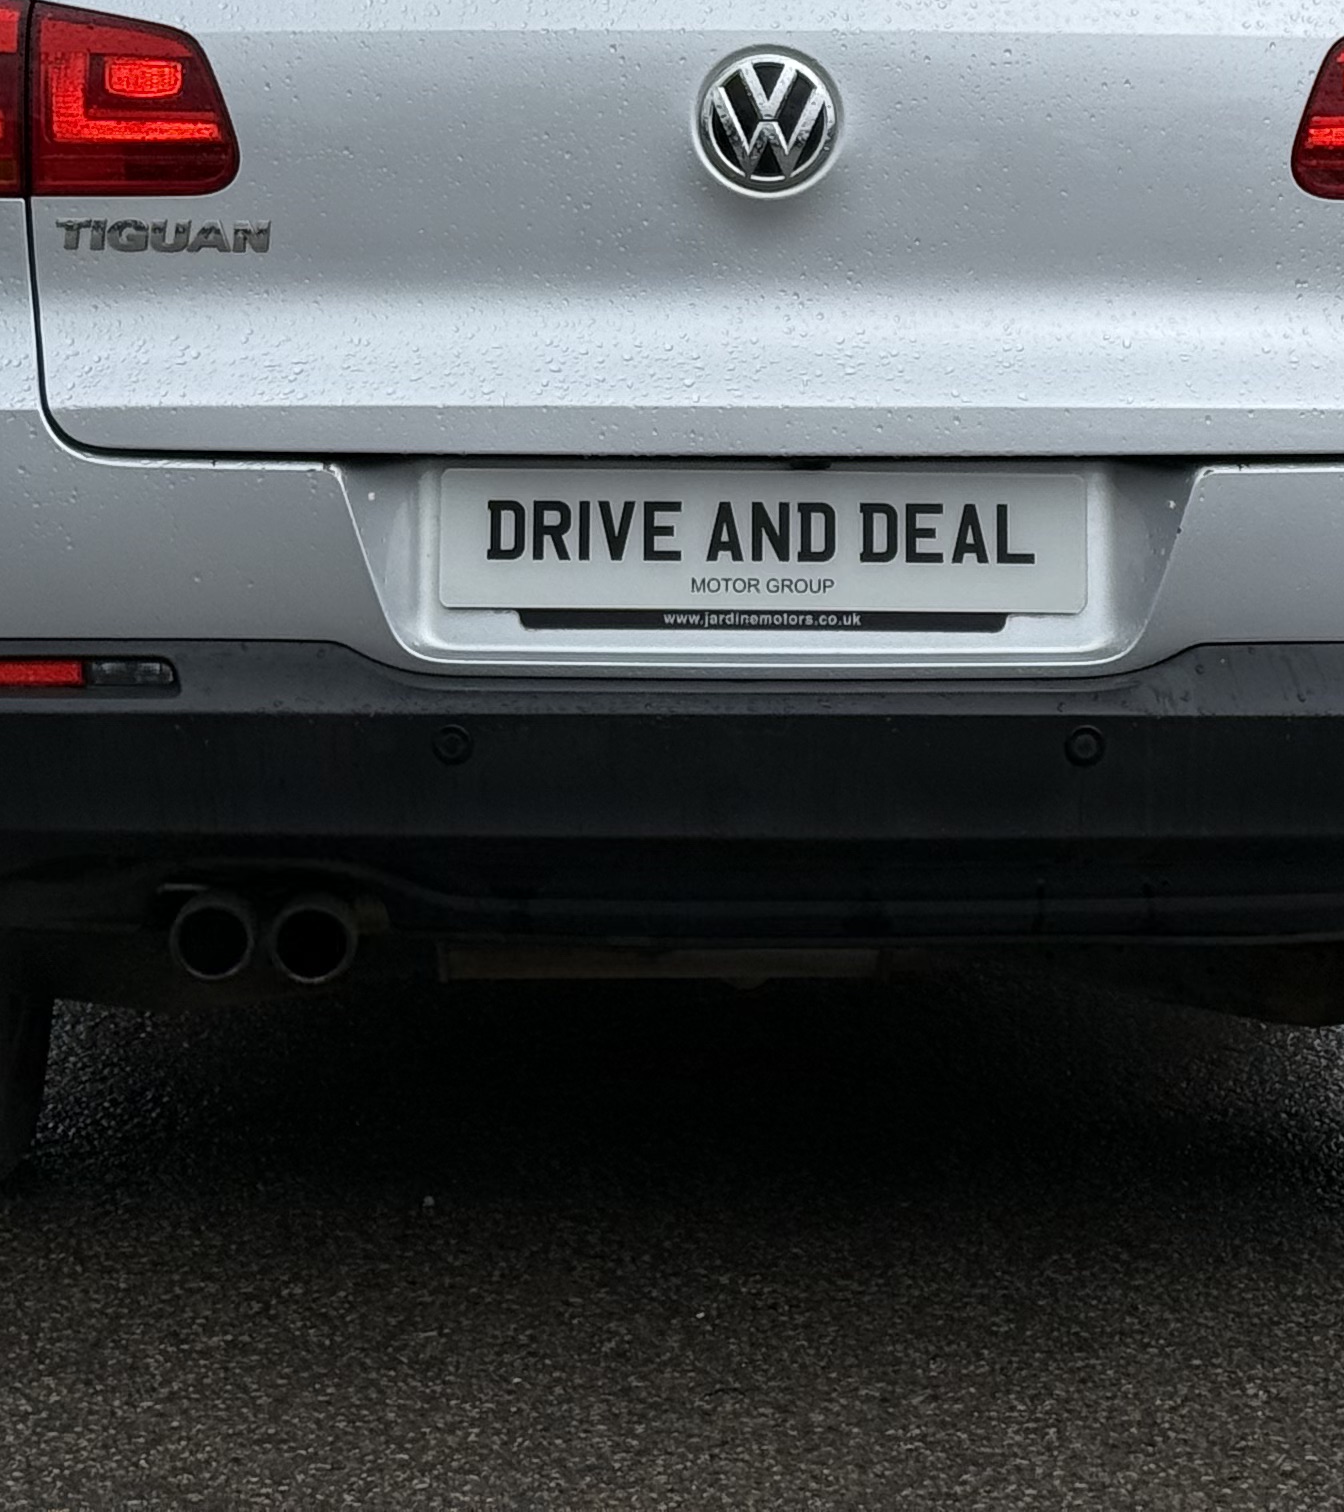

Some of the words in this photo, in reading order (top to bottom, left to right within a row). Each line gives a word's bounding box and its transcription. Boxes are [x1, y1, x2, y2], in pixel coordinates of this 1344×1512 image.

[55, 216, 271, 253] TIGUAN
[487, 500, 682, 561] DRIVE
[706, 501, 835, 562] AND
[860, 502, 1035, 564] DEAL
[691, 577, 760, 594] MOTOR
[766, 578, 835, 595] GROUP
[663, 611, 861, 630] www.jardinemotors.co.uk
